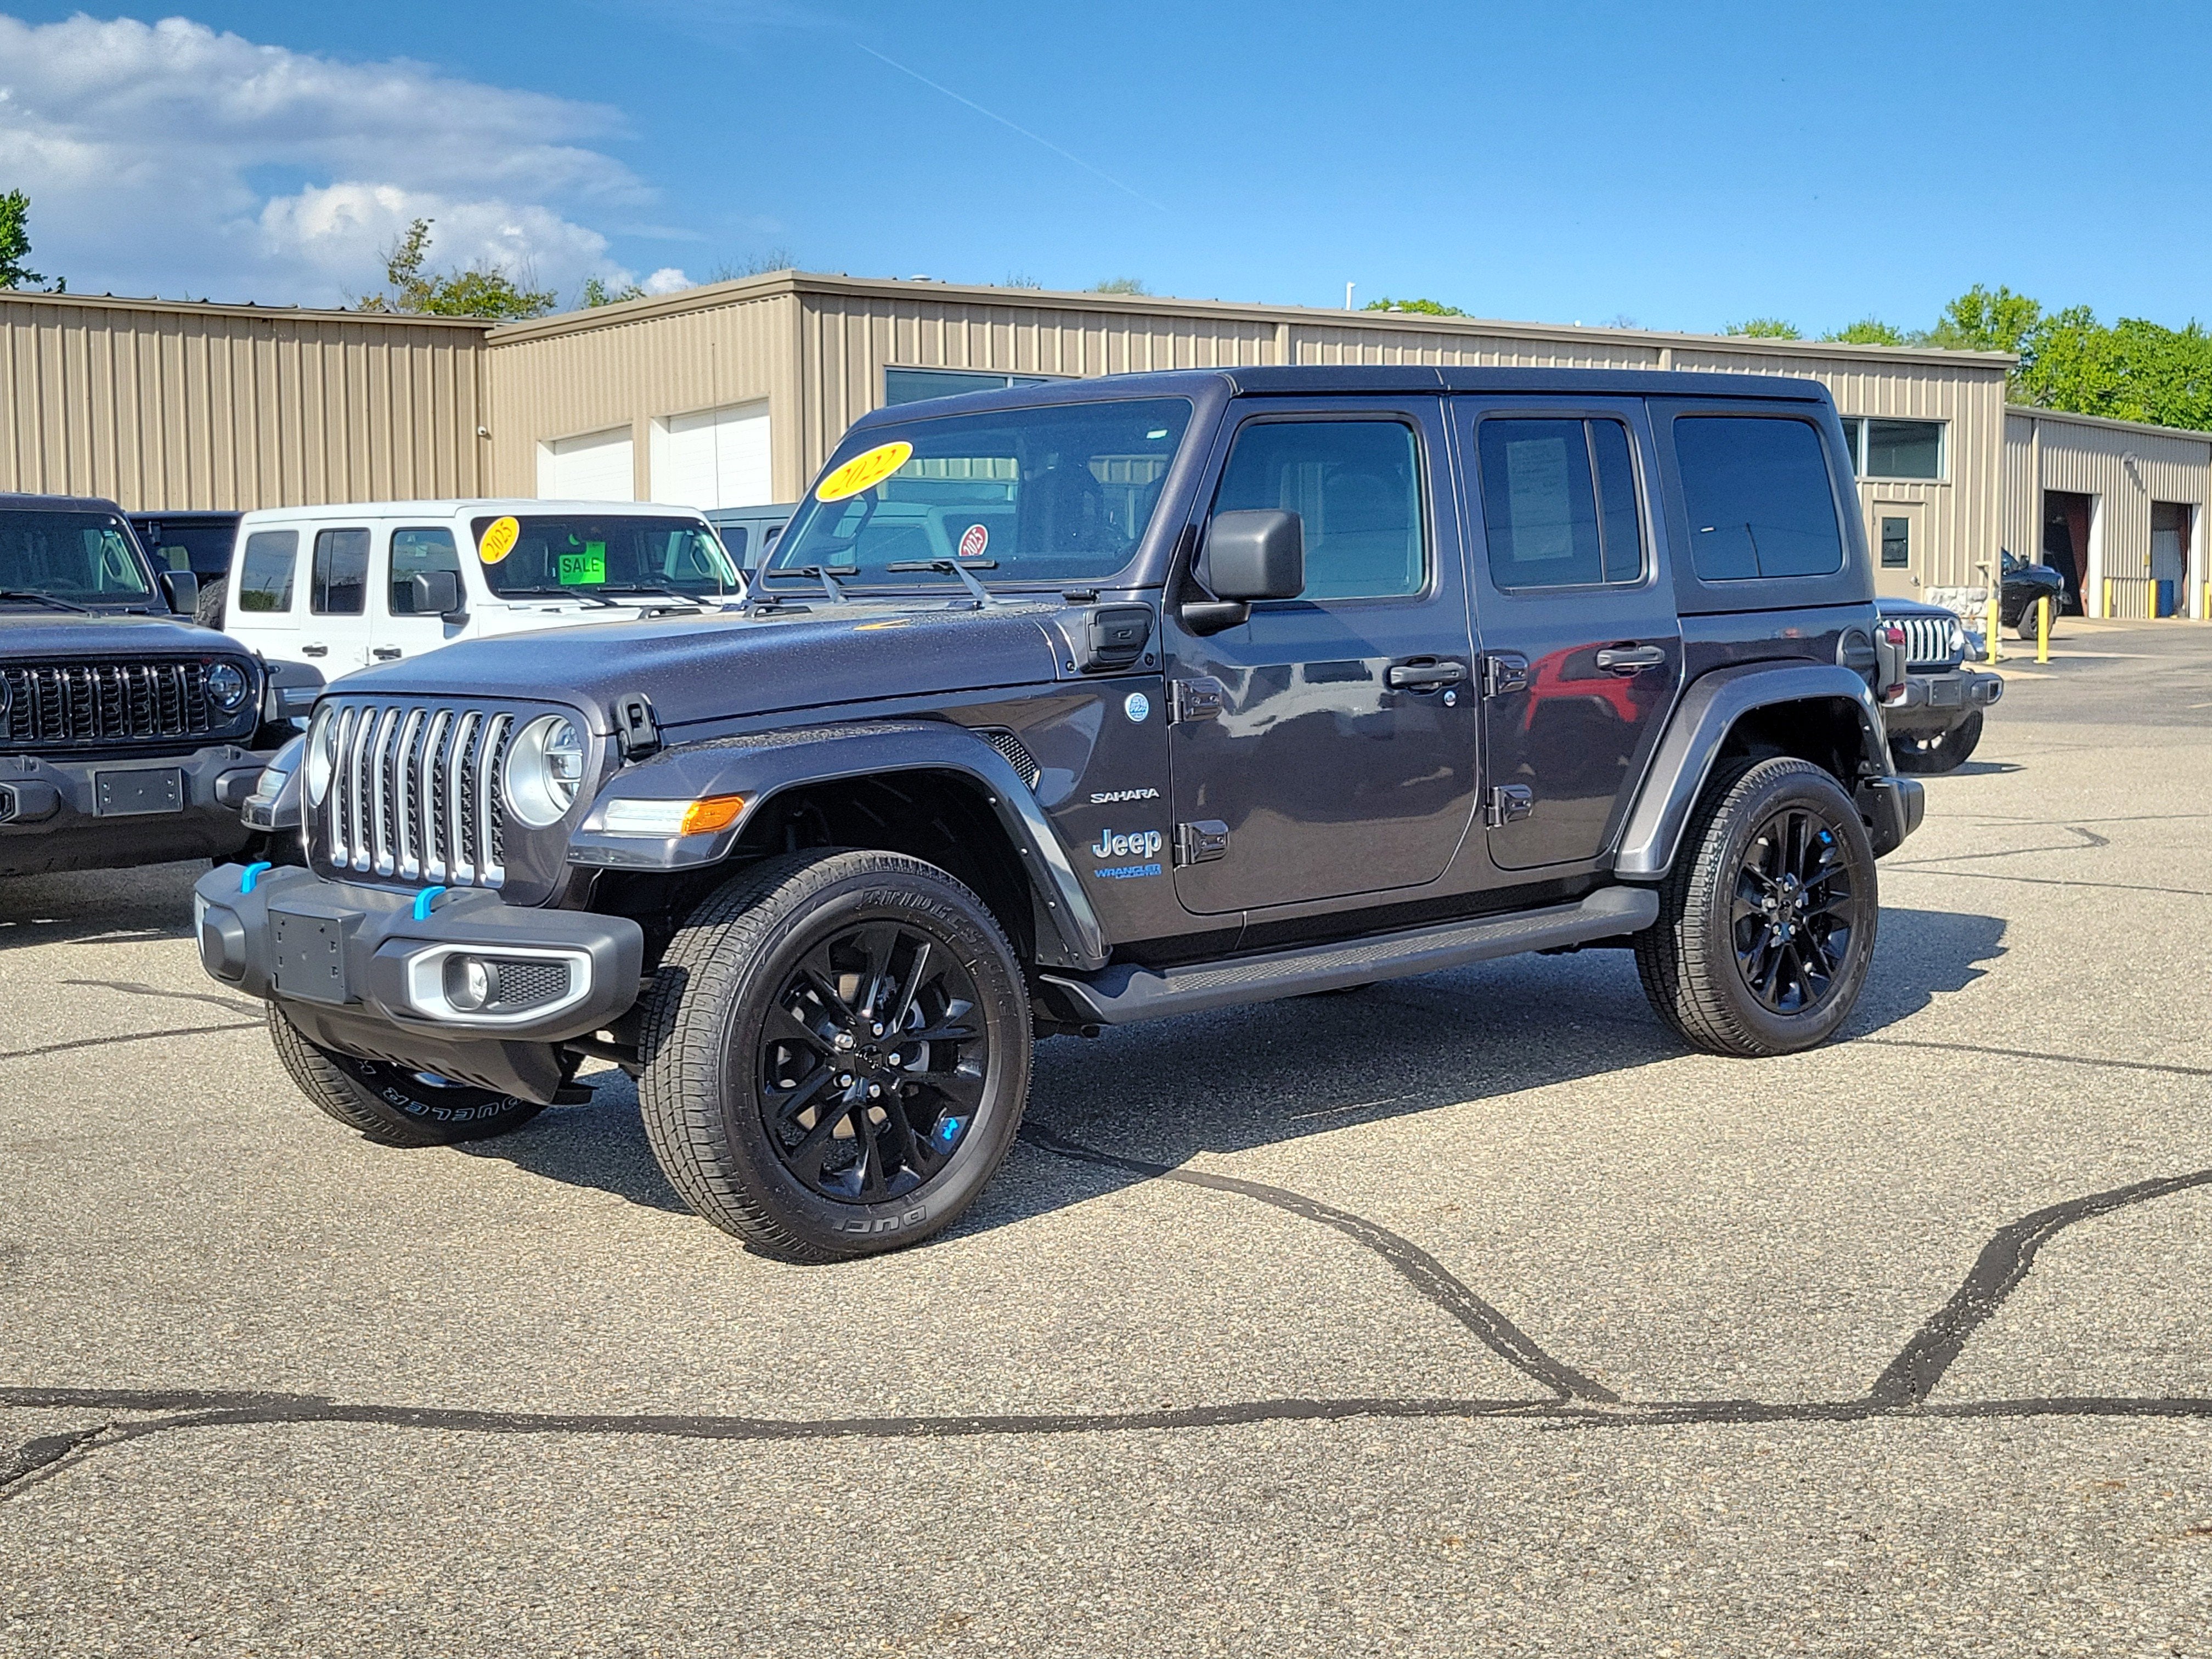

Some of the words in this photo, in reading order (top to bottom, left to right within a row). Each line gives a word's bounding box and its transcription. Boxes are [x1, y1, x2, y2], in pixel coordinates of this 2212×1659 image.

[829, 448, 897, 495] 2022
[486, 521, 513, 558] 2025
[963, 528, 984, 556] 2025
[562, 556, 601, 573] SALE
[1090, 788, 1160, 804] SAHARA
[1092, 829, 1162, 859] Jeep
[1094, 864, 1161, 877] WRANGLER
[382, 1087, 523, 1121] DUELER
